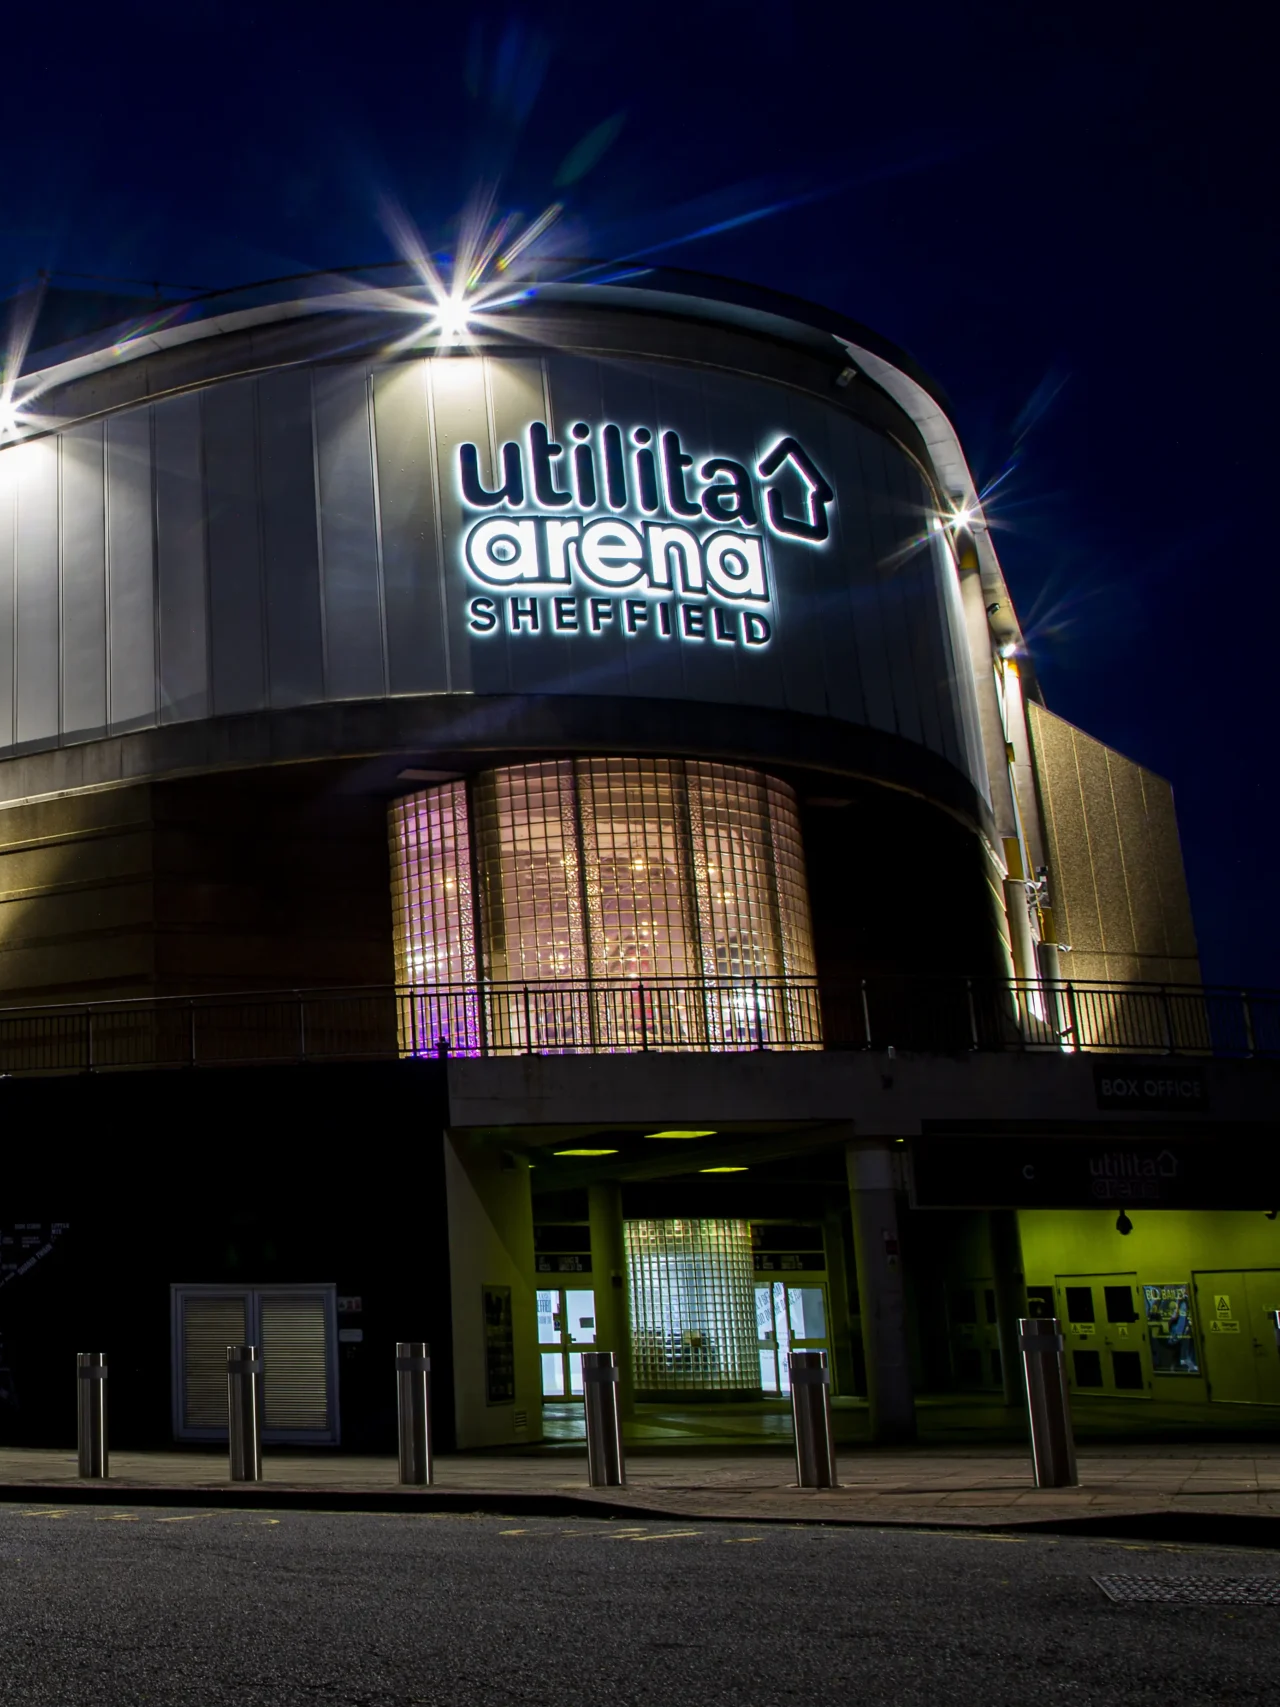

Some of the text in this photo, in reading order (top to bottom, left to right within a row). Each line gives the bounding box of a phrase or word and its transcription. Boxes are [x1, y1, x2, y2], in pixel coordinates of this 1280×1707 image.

[459, 421, 757, 527] utilita
[465, 515, 770, 602] arena
[470, 598, 772, 646] SHEFFIELD
[1101, 1078, 1201, 1098] BOX OFFICE
[1088, 1152, 1158, 1177] utilita
